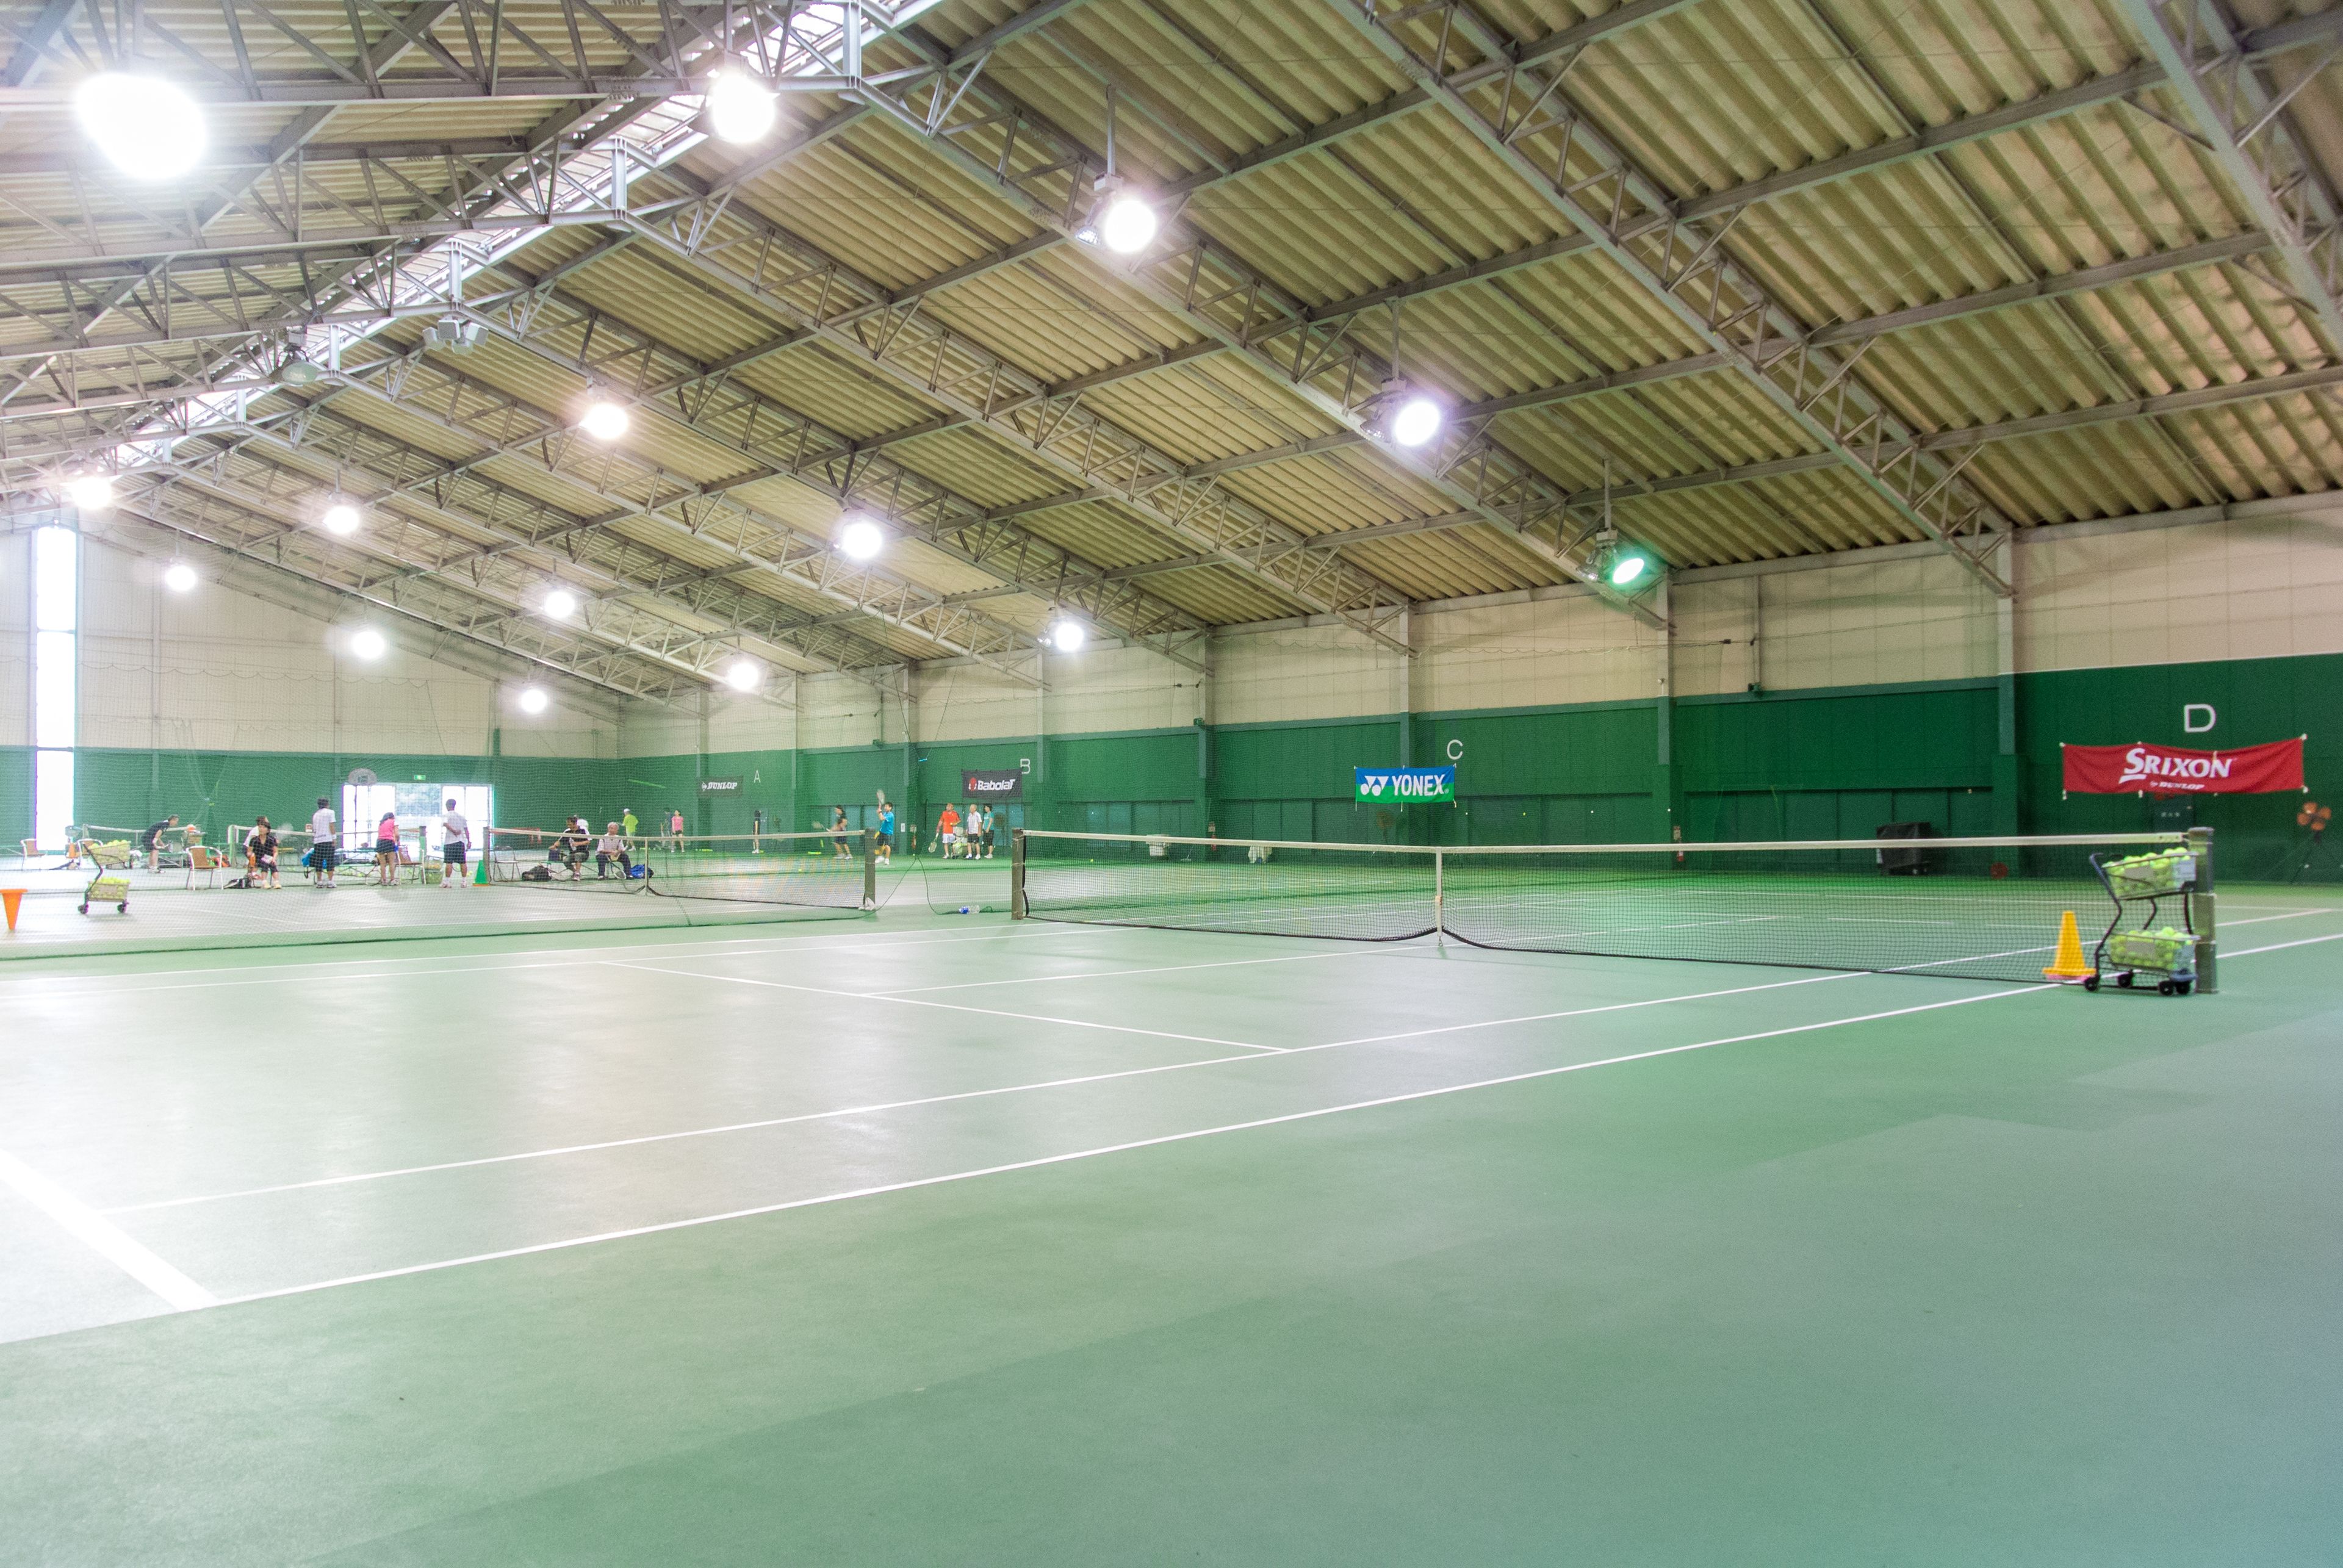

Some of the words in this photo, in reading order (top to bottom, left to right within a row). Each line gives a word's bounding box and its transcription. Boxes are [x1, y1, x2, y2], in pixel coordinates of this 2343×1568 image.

[2184, 704, 2216, 732] D
[1447, 739, 1463, 760] C
[1020, 758, 1031, 774] B
[2122, 747, 2234, 779] SRIXON
[754, 770, 761, 783] A
[1391, 774, 1445, 796] YONEX
[2158, 781, 2205, 790] DUNLOP
